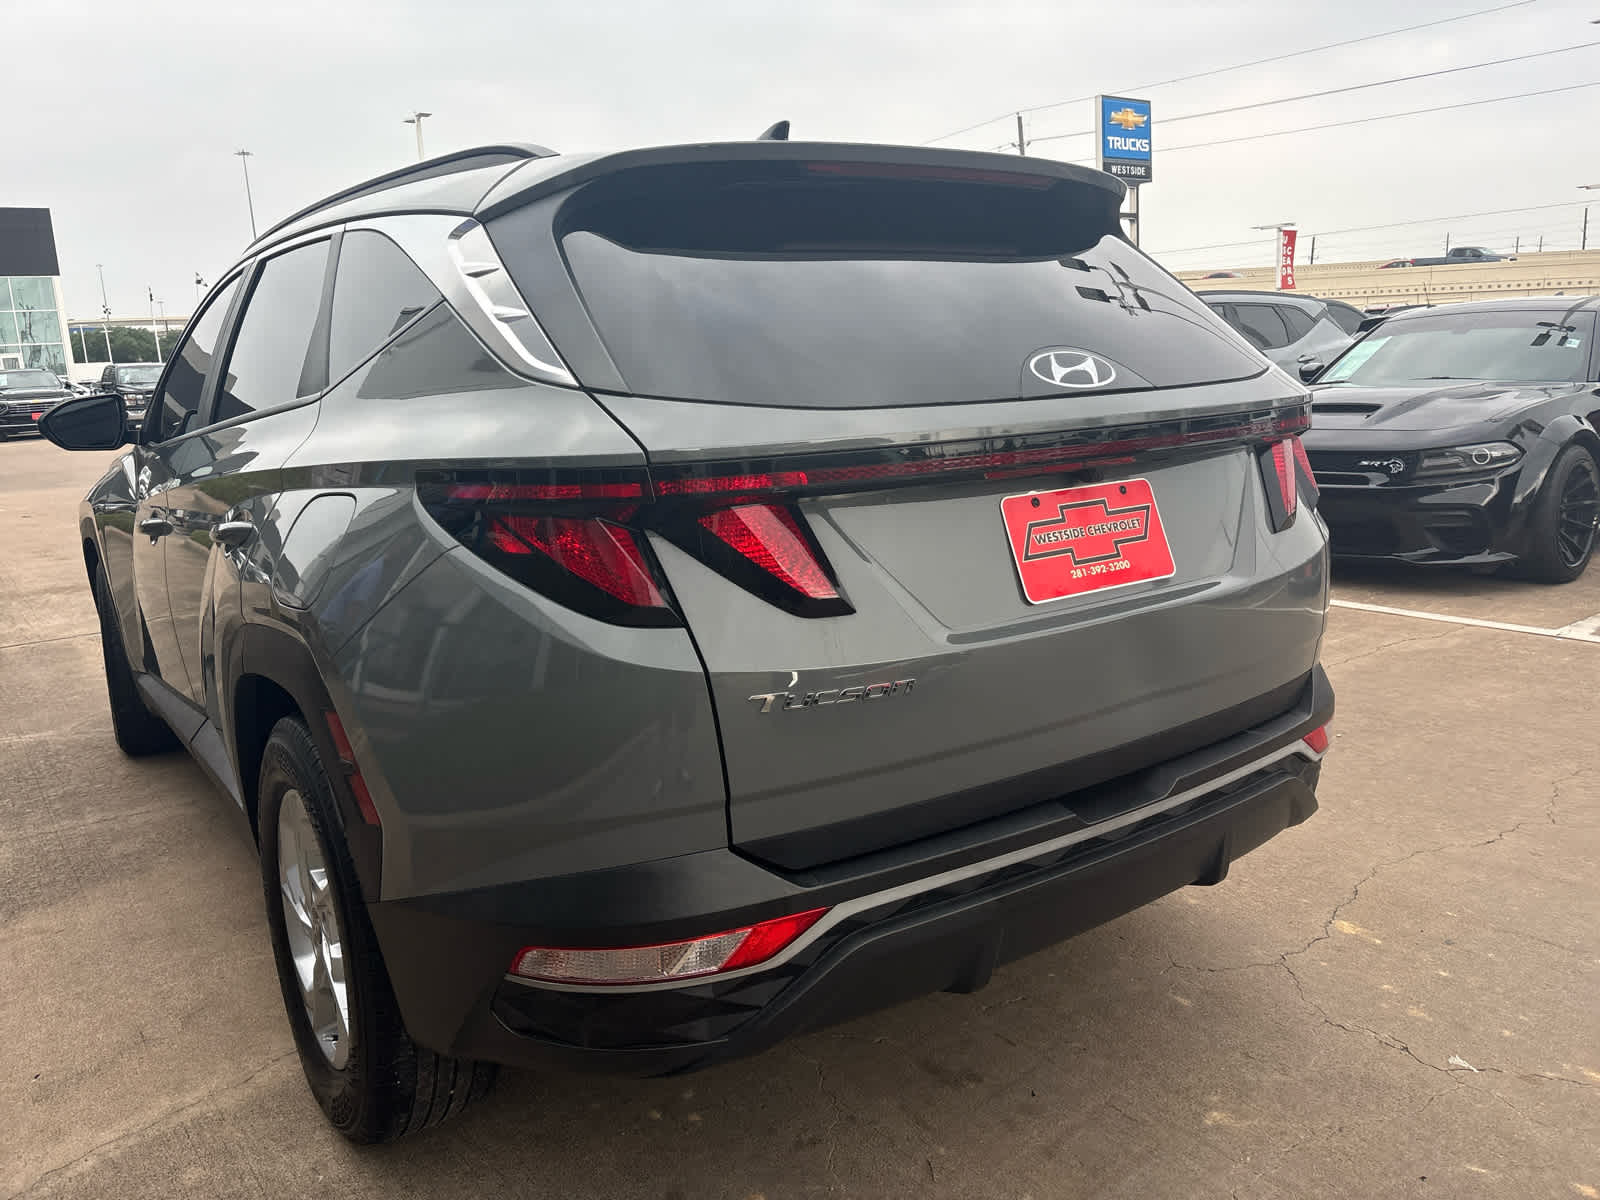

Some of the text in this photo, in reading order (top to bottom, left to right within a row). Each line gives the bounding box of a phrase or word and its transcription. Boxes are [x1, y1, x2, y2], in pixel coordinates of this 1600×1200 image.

[1107, 136, 1149, 152] TRUCKS
[1111, 165, 1146, 176] WESTSIDE
[1034, 518, 1142, 545] WESTSIDE CHEVROLET
[1070, 560, 1131, 578] 281-392-3200
[748, 678, 916, 712] TUCSON
